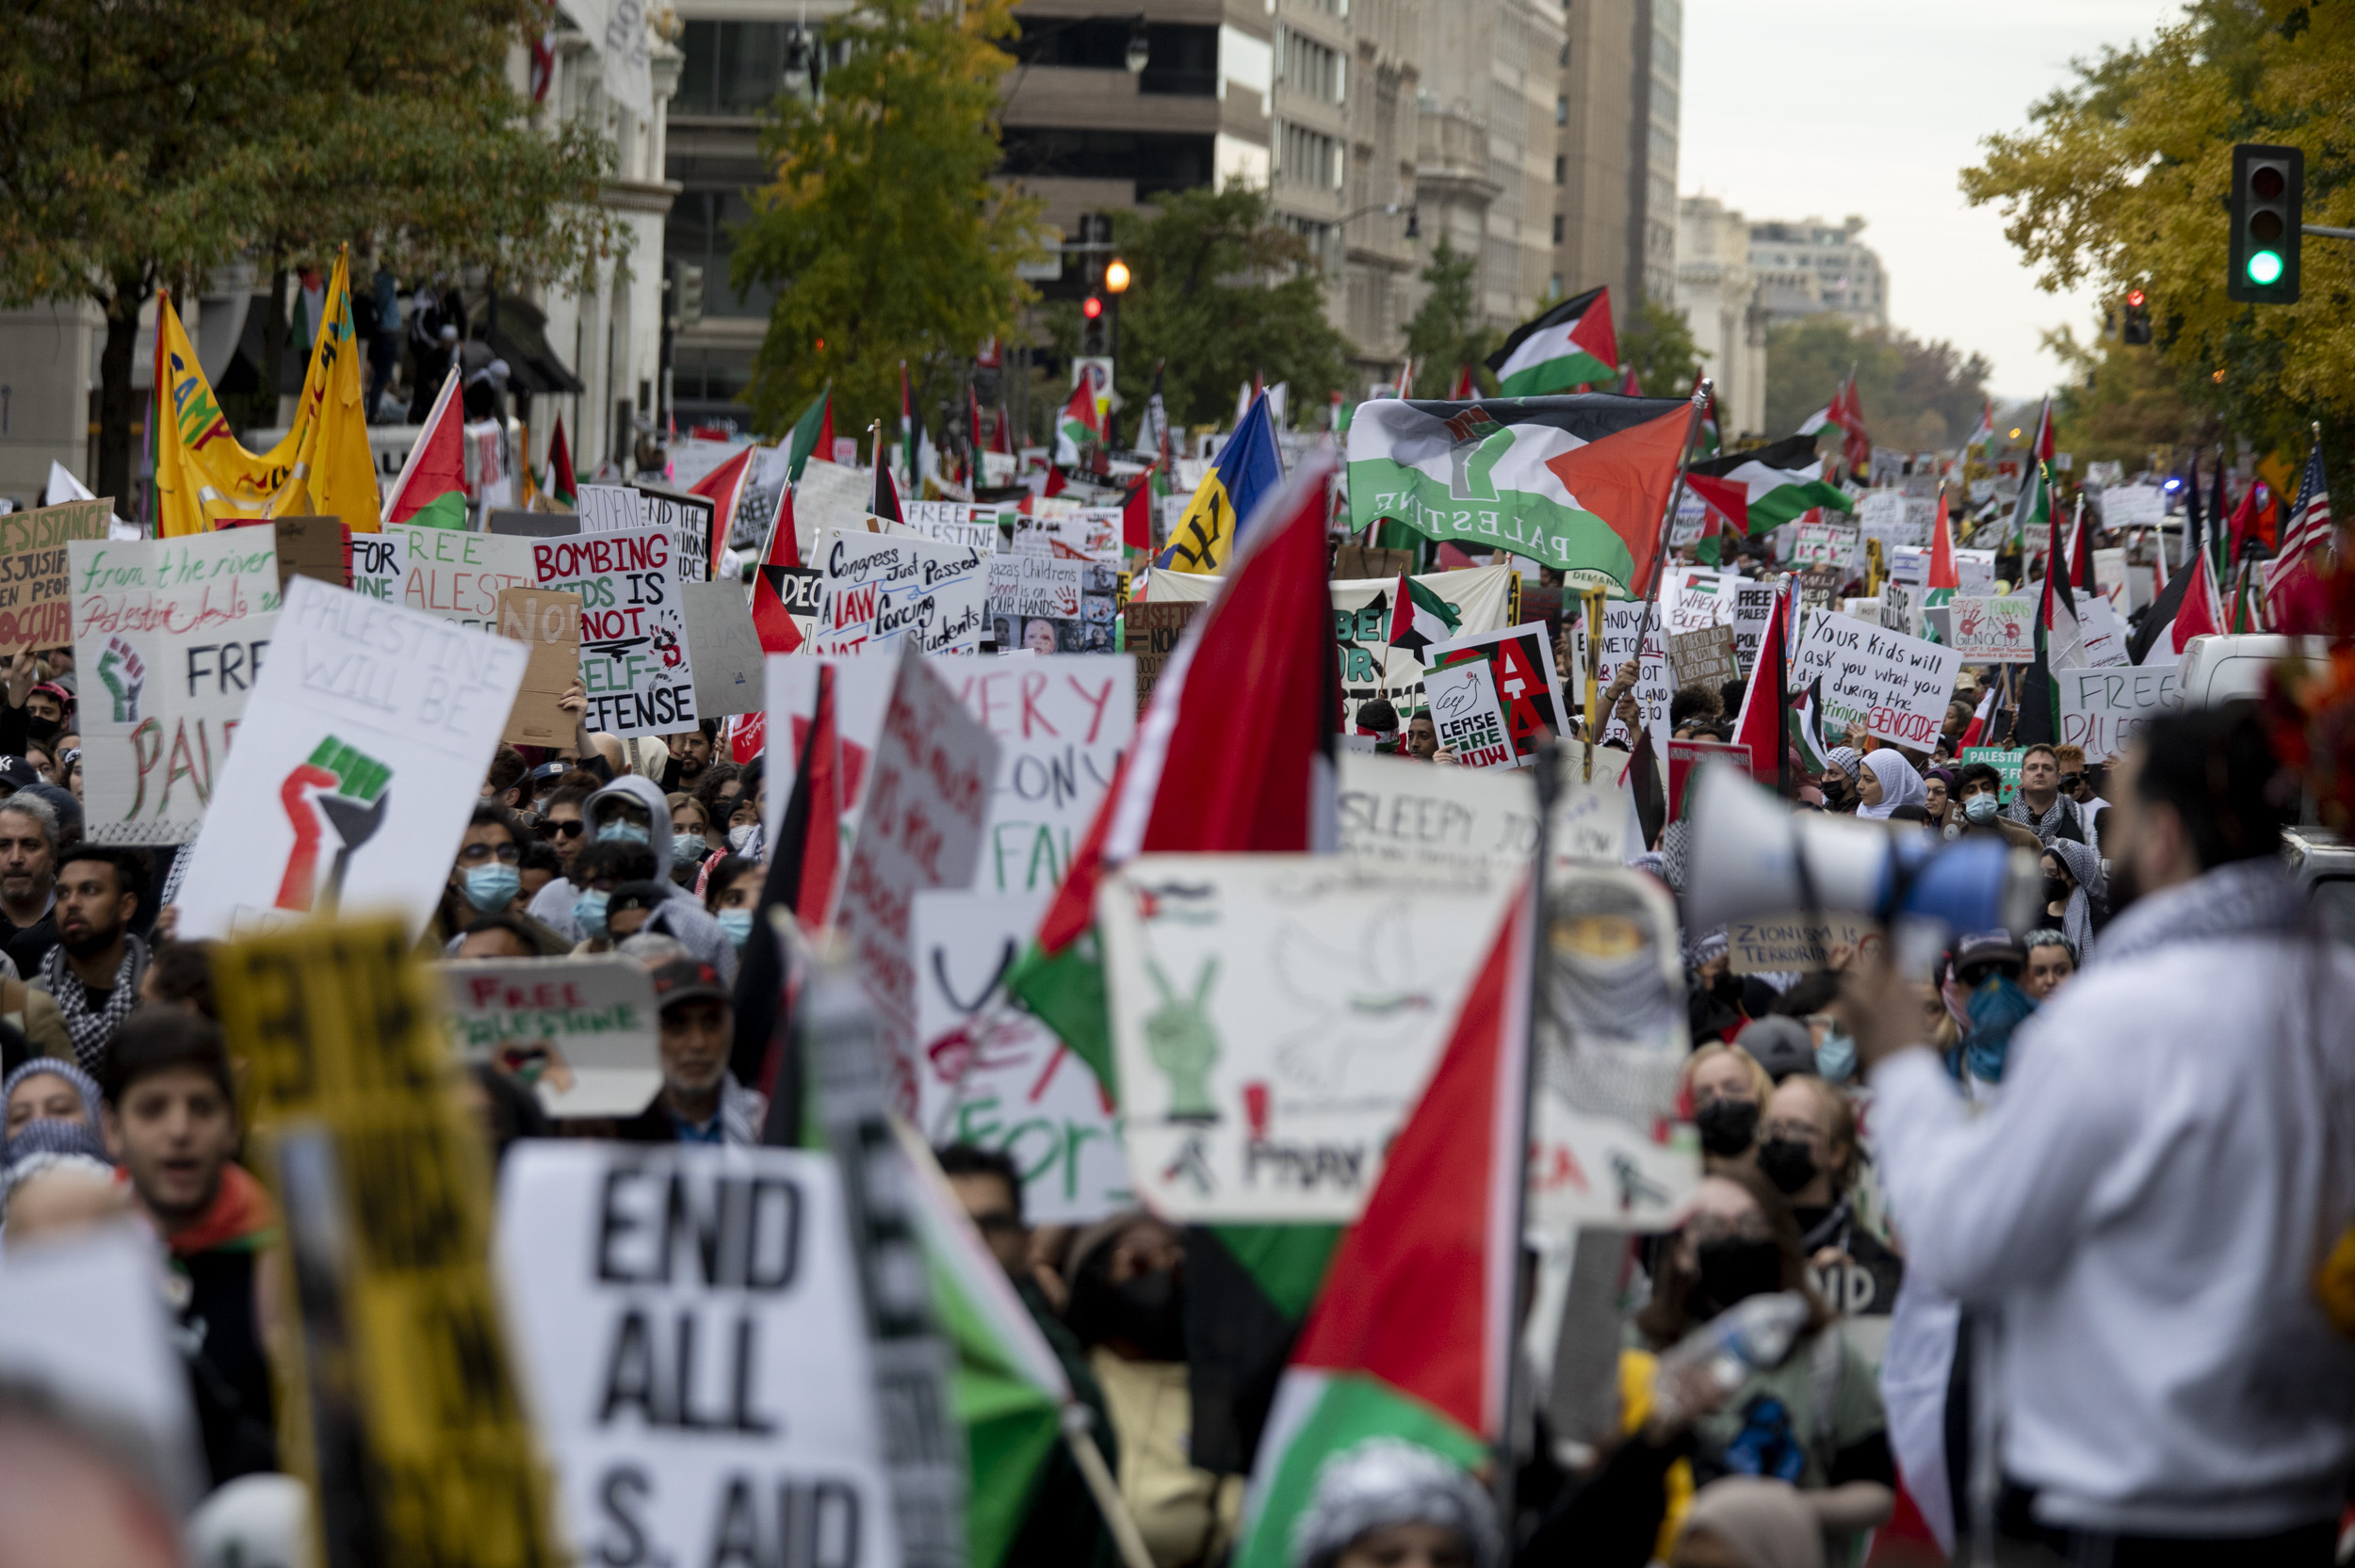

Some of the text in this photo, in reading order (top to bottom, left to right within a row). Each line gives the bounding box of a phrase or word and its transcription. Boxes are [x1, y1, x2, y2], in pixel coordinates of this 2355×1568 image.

[677, 504, 706, 534] THE
[909, 502, 966, 524] FREE
[0, 505, 110, 556] ESISTANCE
[387, 528, 484, 565] FREE
[533, 534, 669, 582] BOMBING
[14, 549, 70, 581] JUSIF
[830, 541, 981, 586] Congress Just Passed
[989, 558, 1078, 582] aza's Children's
[32, 577, 70, 602] PEOP
[626, 572, 665, 606] IS
[1021, 584, 1030, 597] is
[1032, 585, 1047, 600] on
[1738, 590, 1771, 606] FREE
[1887, 585, 1908, 609] STOP
[822, 590, 832, 624] A
[835, 581, 876, 630] LAW
[990, 597, 1057, 615] OUR HANDS
[1737, 608, 1771, 620] PALES
[1951, 599, 1983, 616] STOP
[0, 601, 73, 645] OCCUP
[580, 607, 645, 642] NOT
[1988, 616, 1998, 630] A
[300, 585, 513, 692] PALESTINE
[1811, 612, 1860, 651] YOUR
[1910, 654, 1943, 674] will
[1956, 632, 2027, 648] GENOCIDE
[1673, 653, 1683, 668] TO
[1677, 659, 1720, 681] LIBERATION
[1804, 650, 1941, 699] ask you what you
[1637, 687, 1667, 701] LAND
[1886, 689, 1912, 711] the
[2079, 674, 2175, 710] FREE
[587, 685, 695, 733] EFENSE
[1440, 711, 1498, 739] CEASE
[1868, 706, 1941, 745] GENOCIDE
[1737, 924, 1832, 942] ZIONISM
[600, 1165, 804, 1288] END
[598, 1309, 780, 1436] ALL
